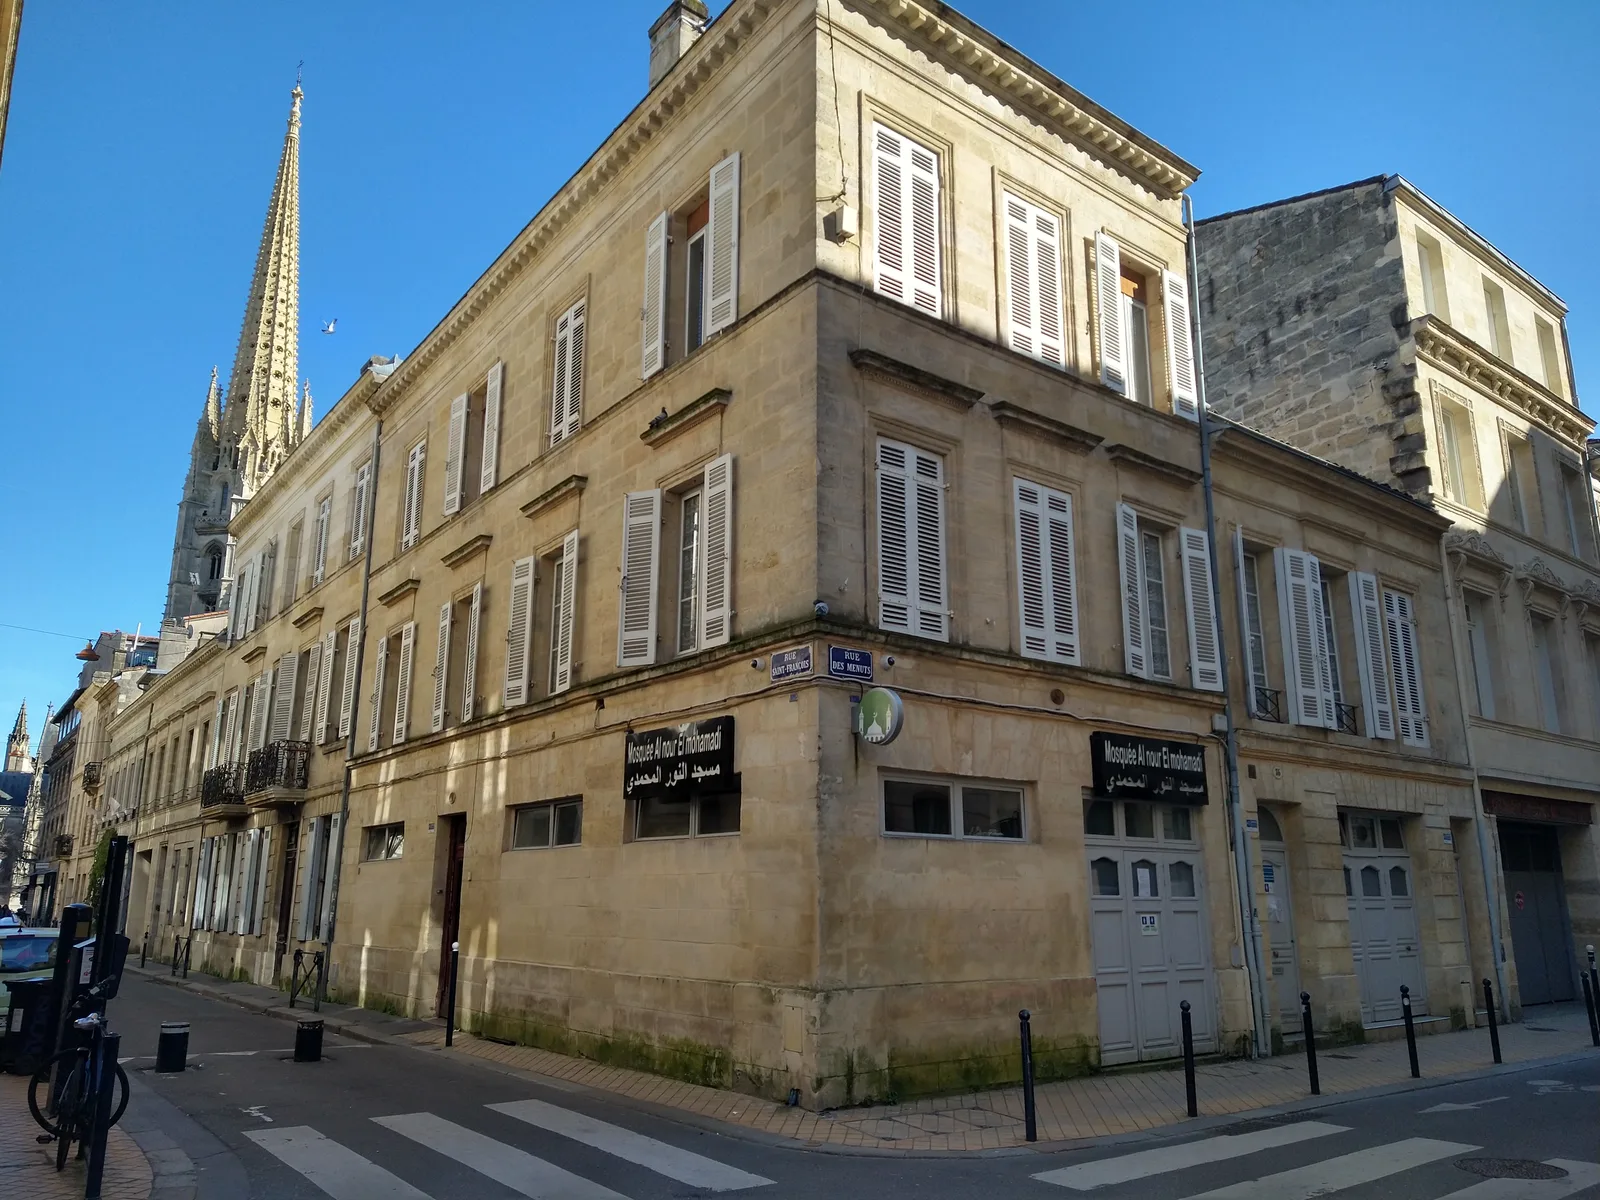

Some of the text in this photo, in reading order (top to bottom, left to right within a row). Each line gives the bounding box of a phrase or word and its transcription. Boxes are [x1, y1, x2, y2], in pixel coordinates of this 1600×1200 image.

[784, 652, 797, 662] RUE
[832, 660, 871, 675] DES MENUTS
[844, 651, 860, 661] RUE
[628, 738, 654, 768] Mosquée
[654, 736, 662, 760] Al
[662, 739, 677, 759] nour
[685, 725, 722, 755] mohamadi
[1104, 740, 1203, 772] Mosquée Al nour El mohamadi
[626, 761, 720, 794] مسجد النور المحمدي
[1105, 773, 1204, 796] مسجد النور المحمدي
